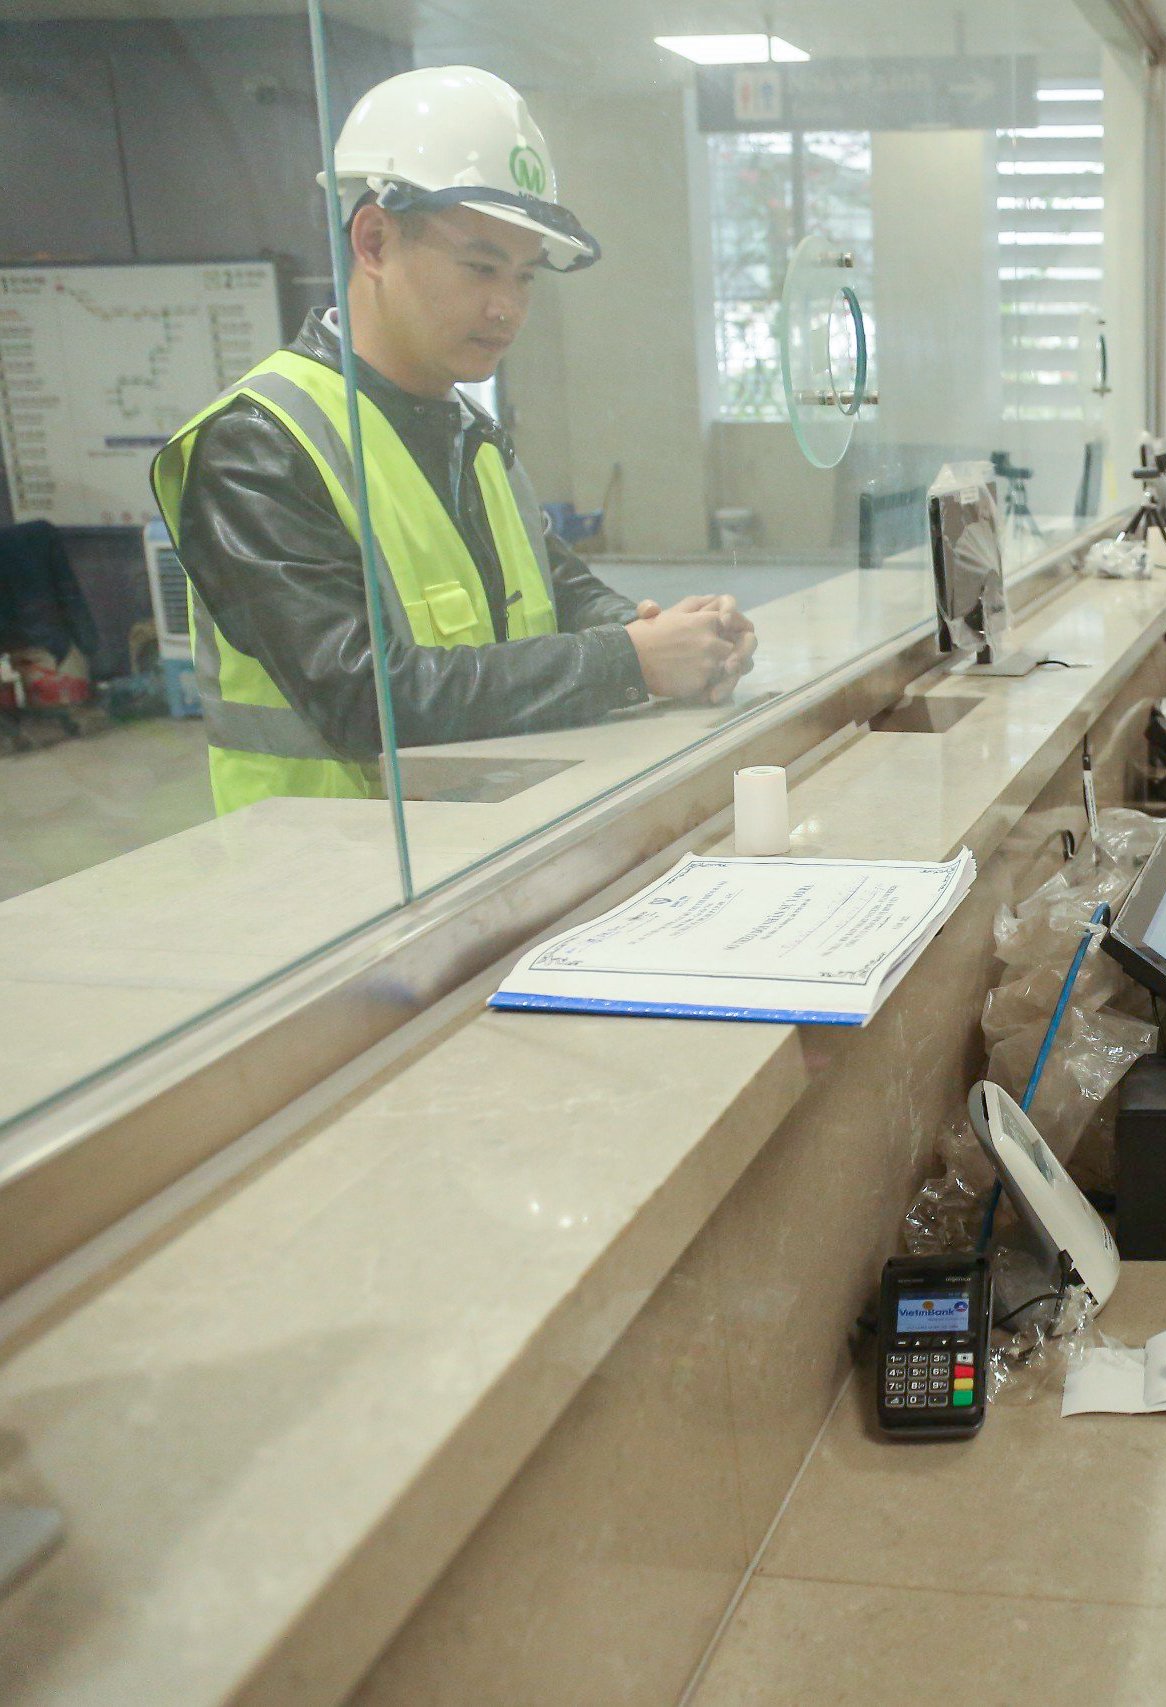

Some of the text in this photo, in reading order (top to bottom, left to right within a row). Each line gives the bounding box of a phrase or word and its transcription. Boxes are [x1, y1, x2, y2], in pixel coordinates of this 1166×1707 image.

[899, 1308, 955, 1318] VietinBank
[890, 1355, 896, 1363] 1
[912, 1355, 919, 1363] 2
[889, 1369, 896, 1377] 4
[911, 1382, 917, 1390] 8
